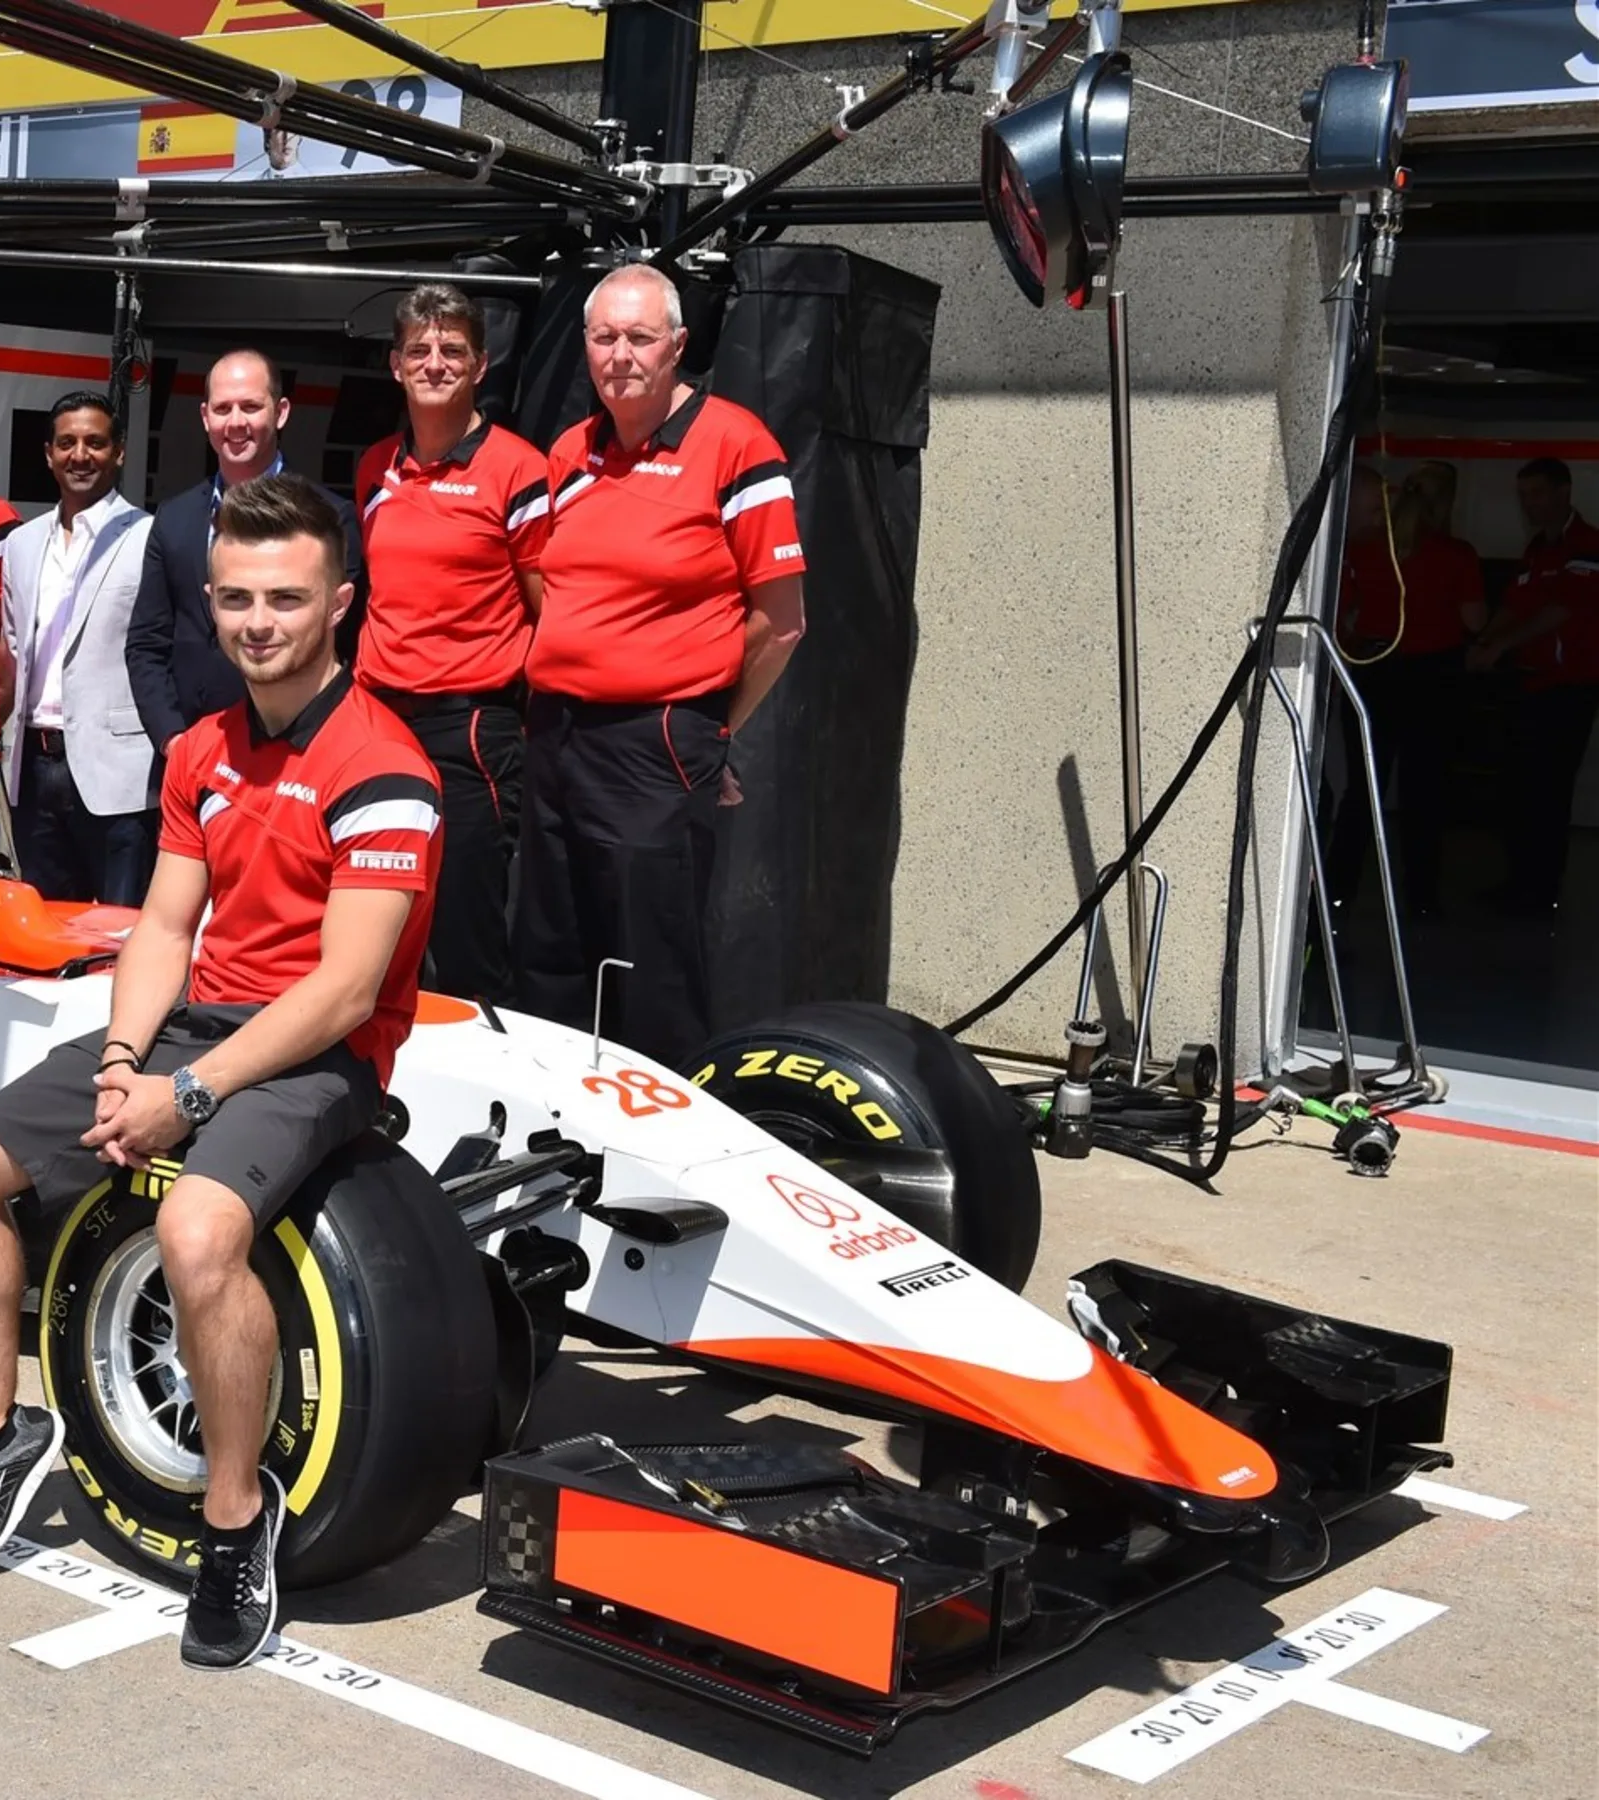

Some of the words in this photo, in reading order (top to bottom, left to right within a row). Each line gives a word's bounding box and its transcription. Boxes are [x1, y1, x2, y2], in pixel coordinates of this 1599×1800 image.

[350, 850, 418, 871] PIRELLI
[581, 1069, 692, 1118] 28
[734, 1049, 903, 1140] ZERO
[829, 1221, 918, 1260] airbnb
[877, 1260, 971, 1297] PIRELLI
[37, 1558, 92, 1579] 20
[99, 1581, 146, 1600] 10
[260, 1646, 319, 1668] 20
[322, 1667, 382, 1690] 30
[1130, 1719, 1186, 1745] 30
[1169, 1700, 1223, 1725] 20
[1212, 1680, 1259, 1701] 10
[1243, 1665, 1284, 1682] 0
[1277, 1643, 1324, 1664] 10
[1304, 1627, 1355, 1650] 20
[1336, 1610, 1387, 1632] 30
